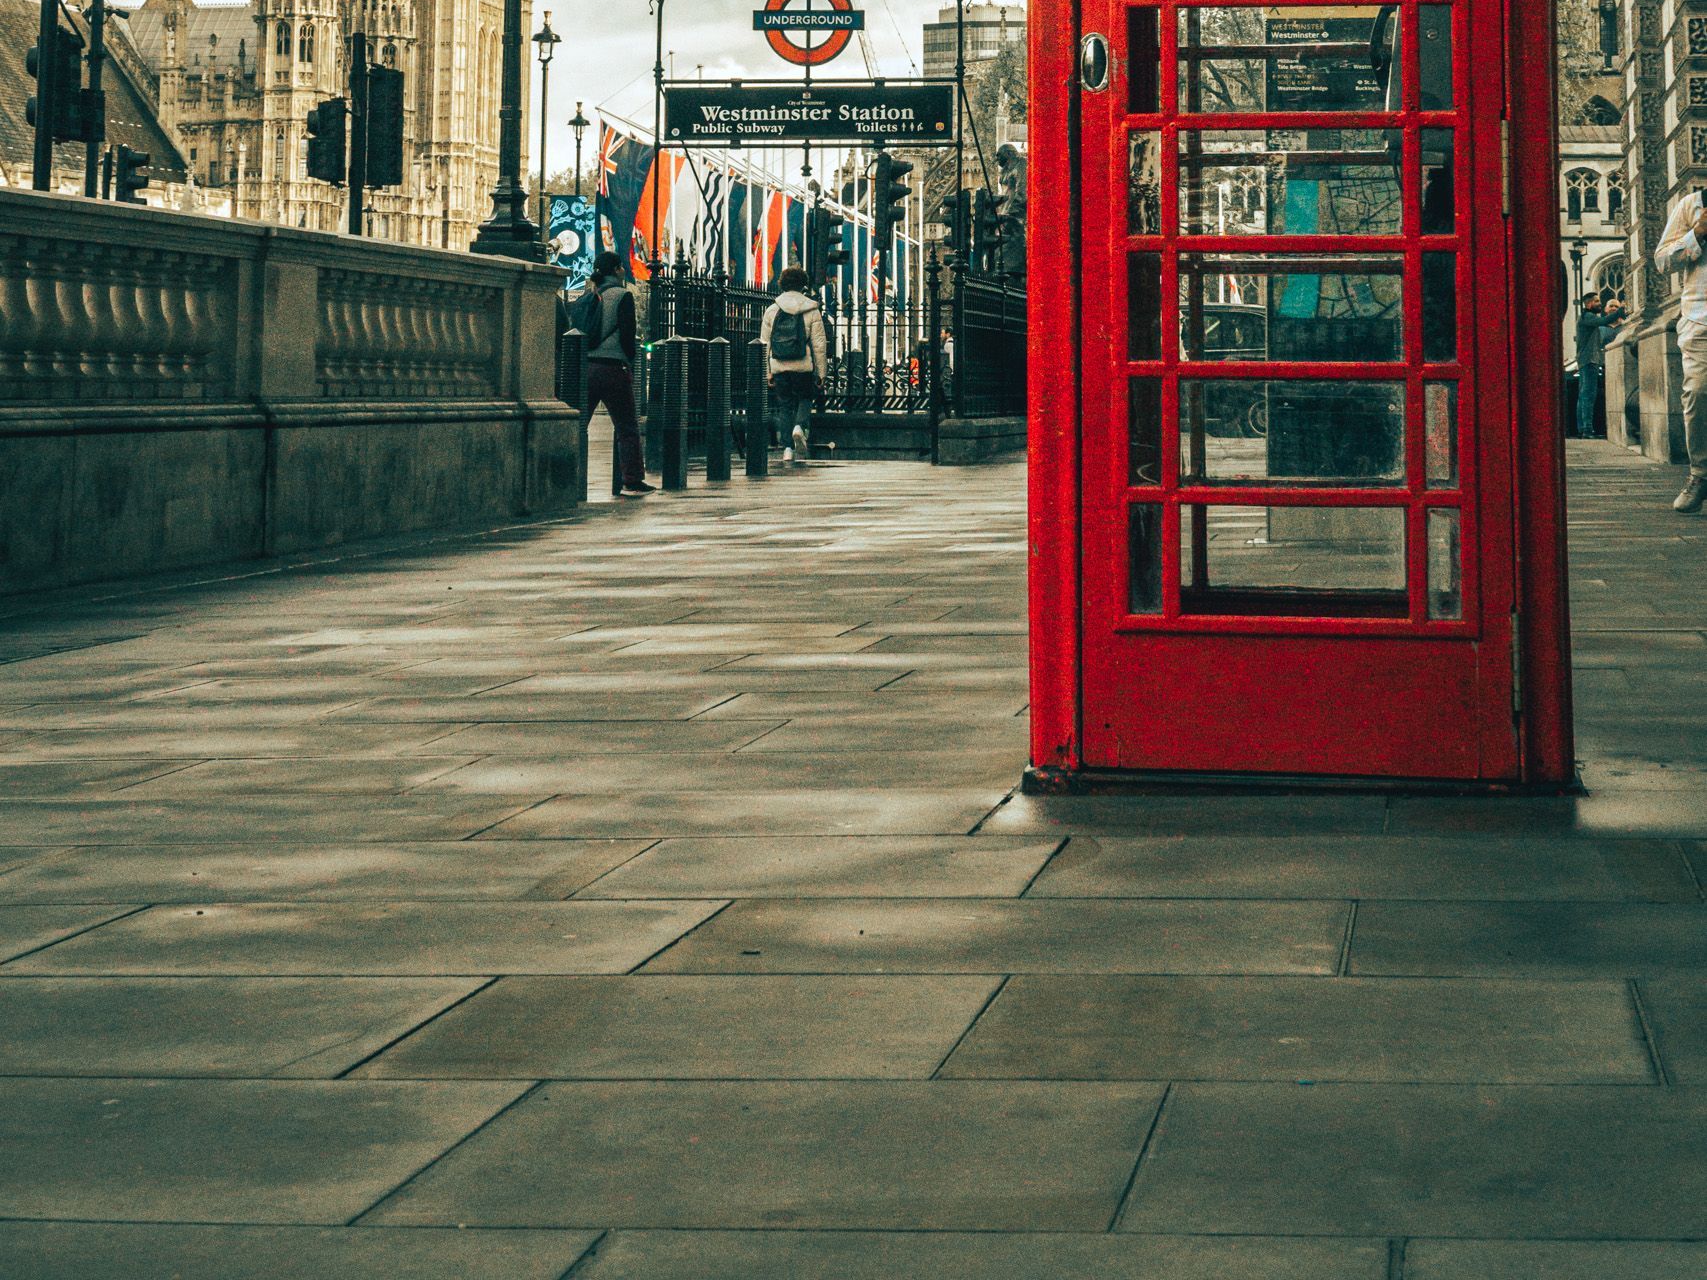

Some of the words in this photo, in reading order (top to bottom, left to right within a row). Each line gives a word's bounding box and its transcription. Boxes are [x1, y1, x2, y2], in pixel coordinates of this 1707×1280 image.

[763, 15, 853, 25] UNDERGROUND
[1271, 23, 1325, 31] WESTMINSTER
[1271, 31, 1320, 39] Westminster
[700, 105, 832, 122] Westminster
[839, 104, 915, 121] Station
[692, 123, 733, 134] Public
[736, 122, 786, 136] Subway
[855, 122, 898, 133] Toilets
